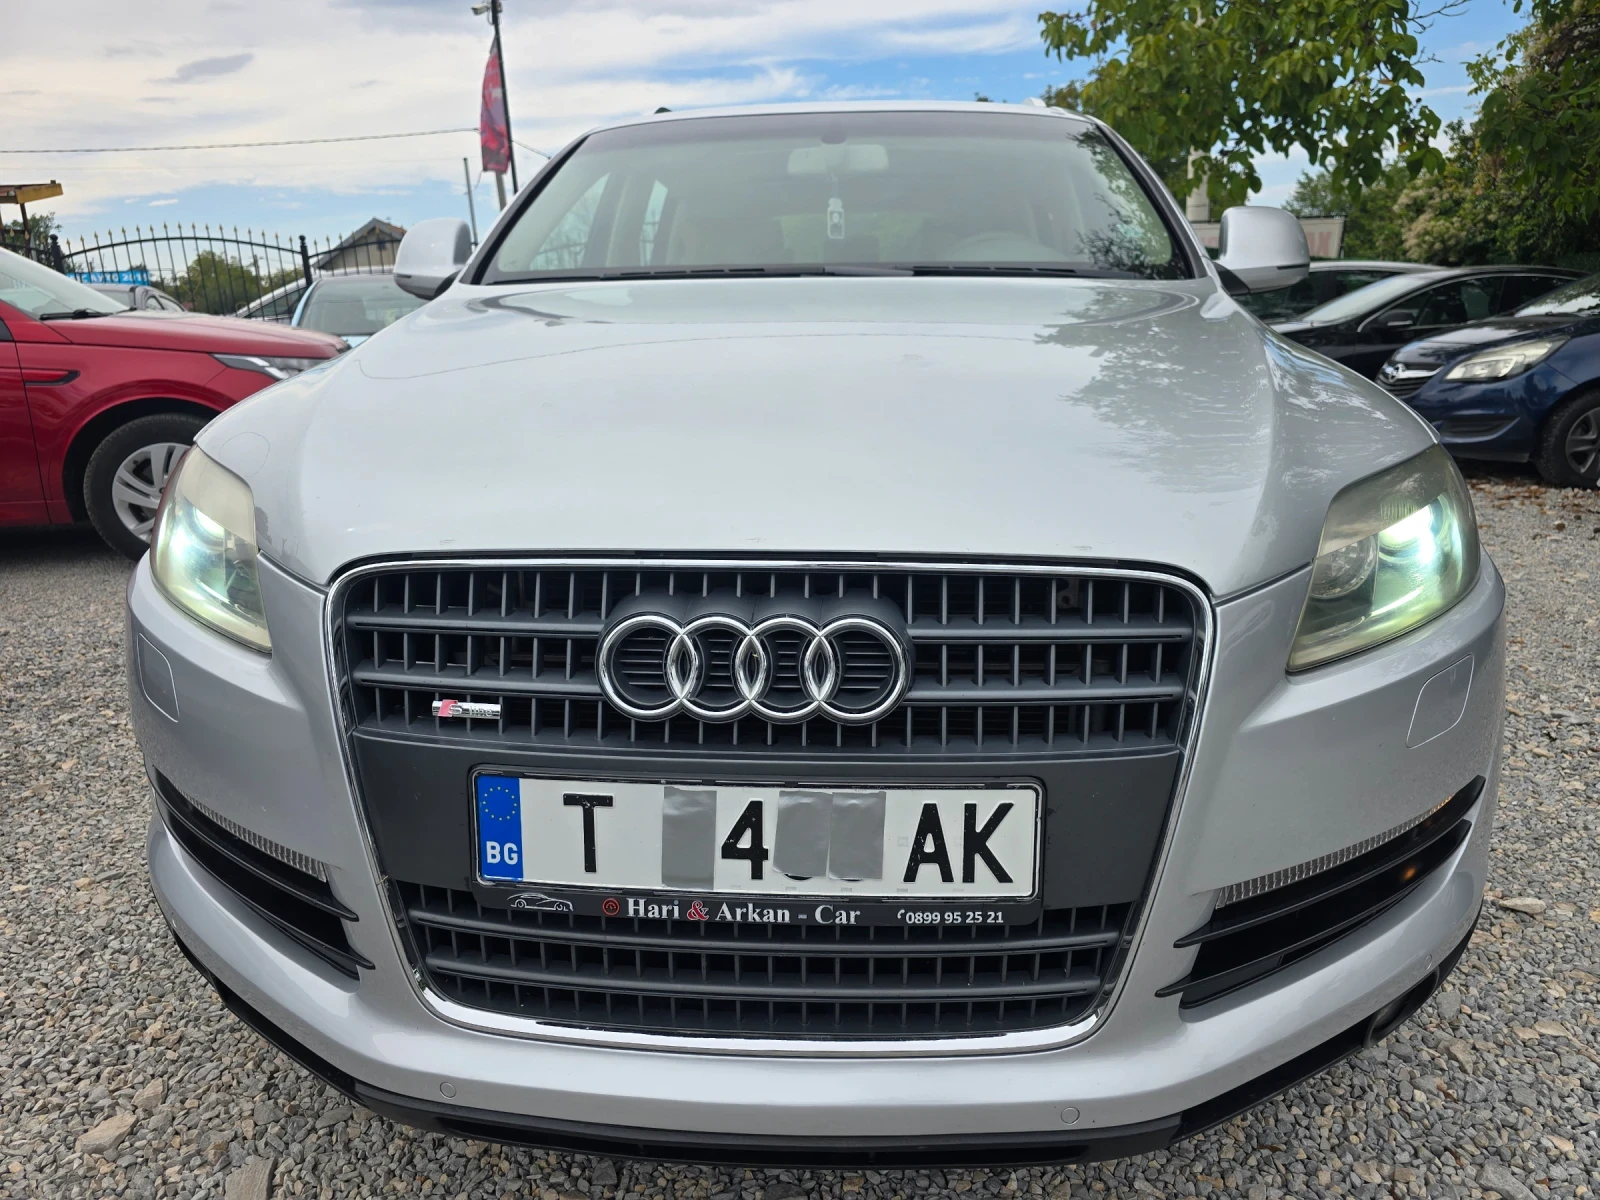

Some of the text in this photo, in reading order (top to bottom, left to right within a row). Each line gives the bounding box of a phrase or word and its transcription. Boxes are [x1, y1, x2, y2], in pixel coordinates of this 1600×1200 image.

[562, 792, 614, 874] T
[902, 802, 1014, 884] AK
[485, 840, 519, 866] BG
[625, 897, 681, 920] Hari
[686, 899, 710, 921] &
[714, 901, 791, 924] Arkan
[814, 904, 861, 925] Car
[905, 911, 1004, 924] 0899 95 25 21
